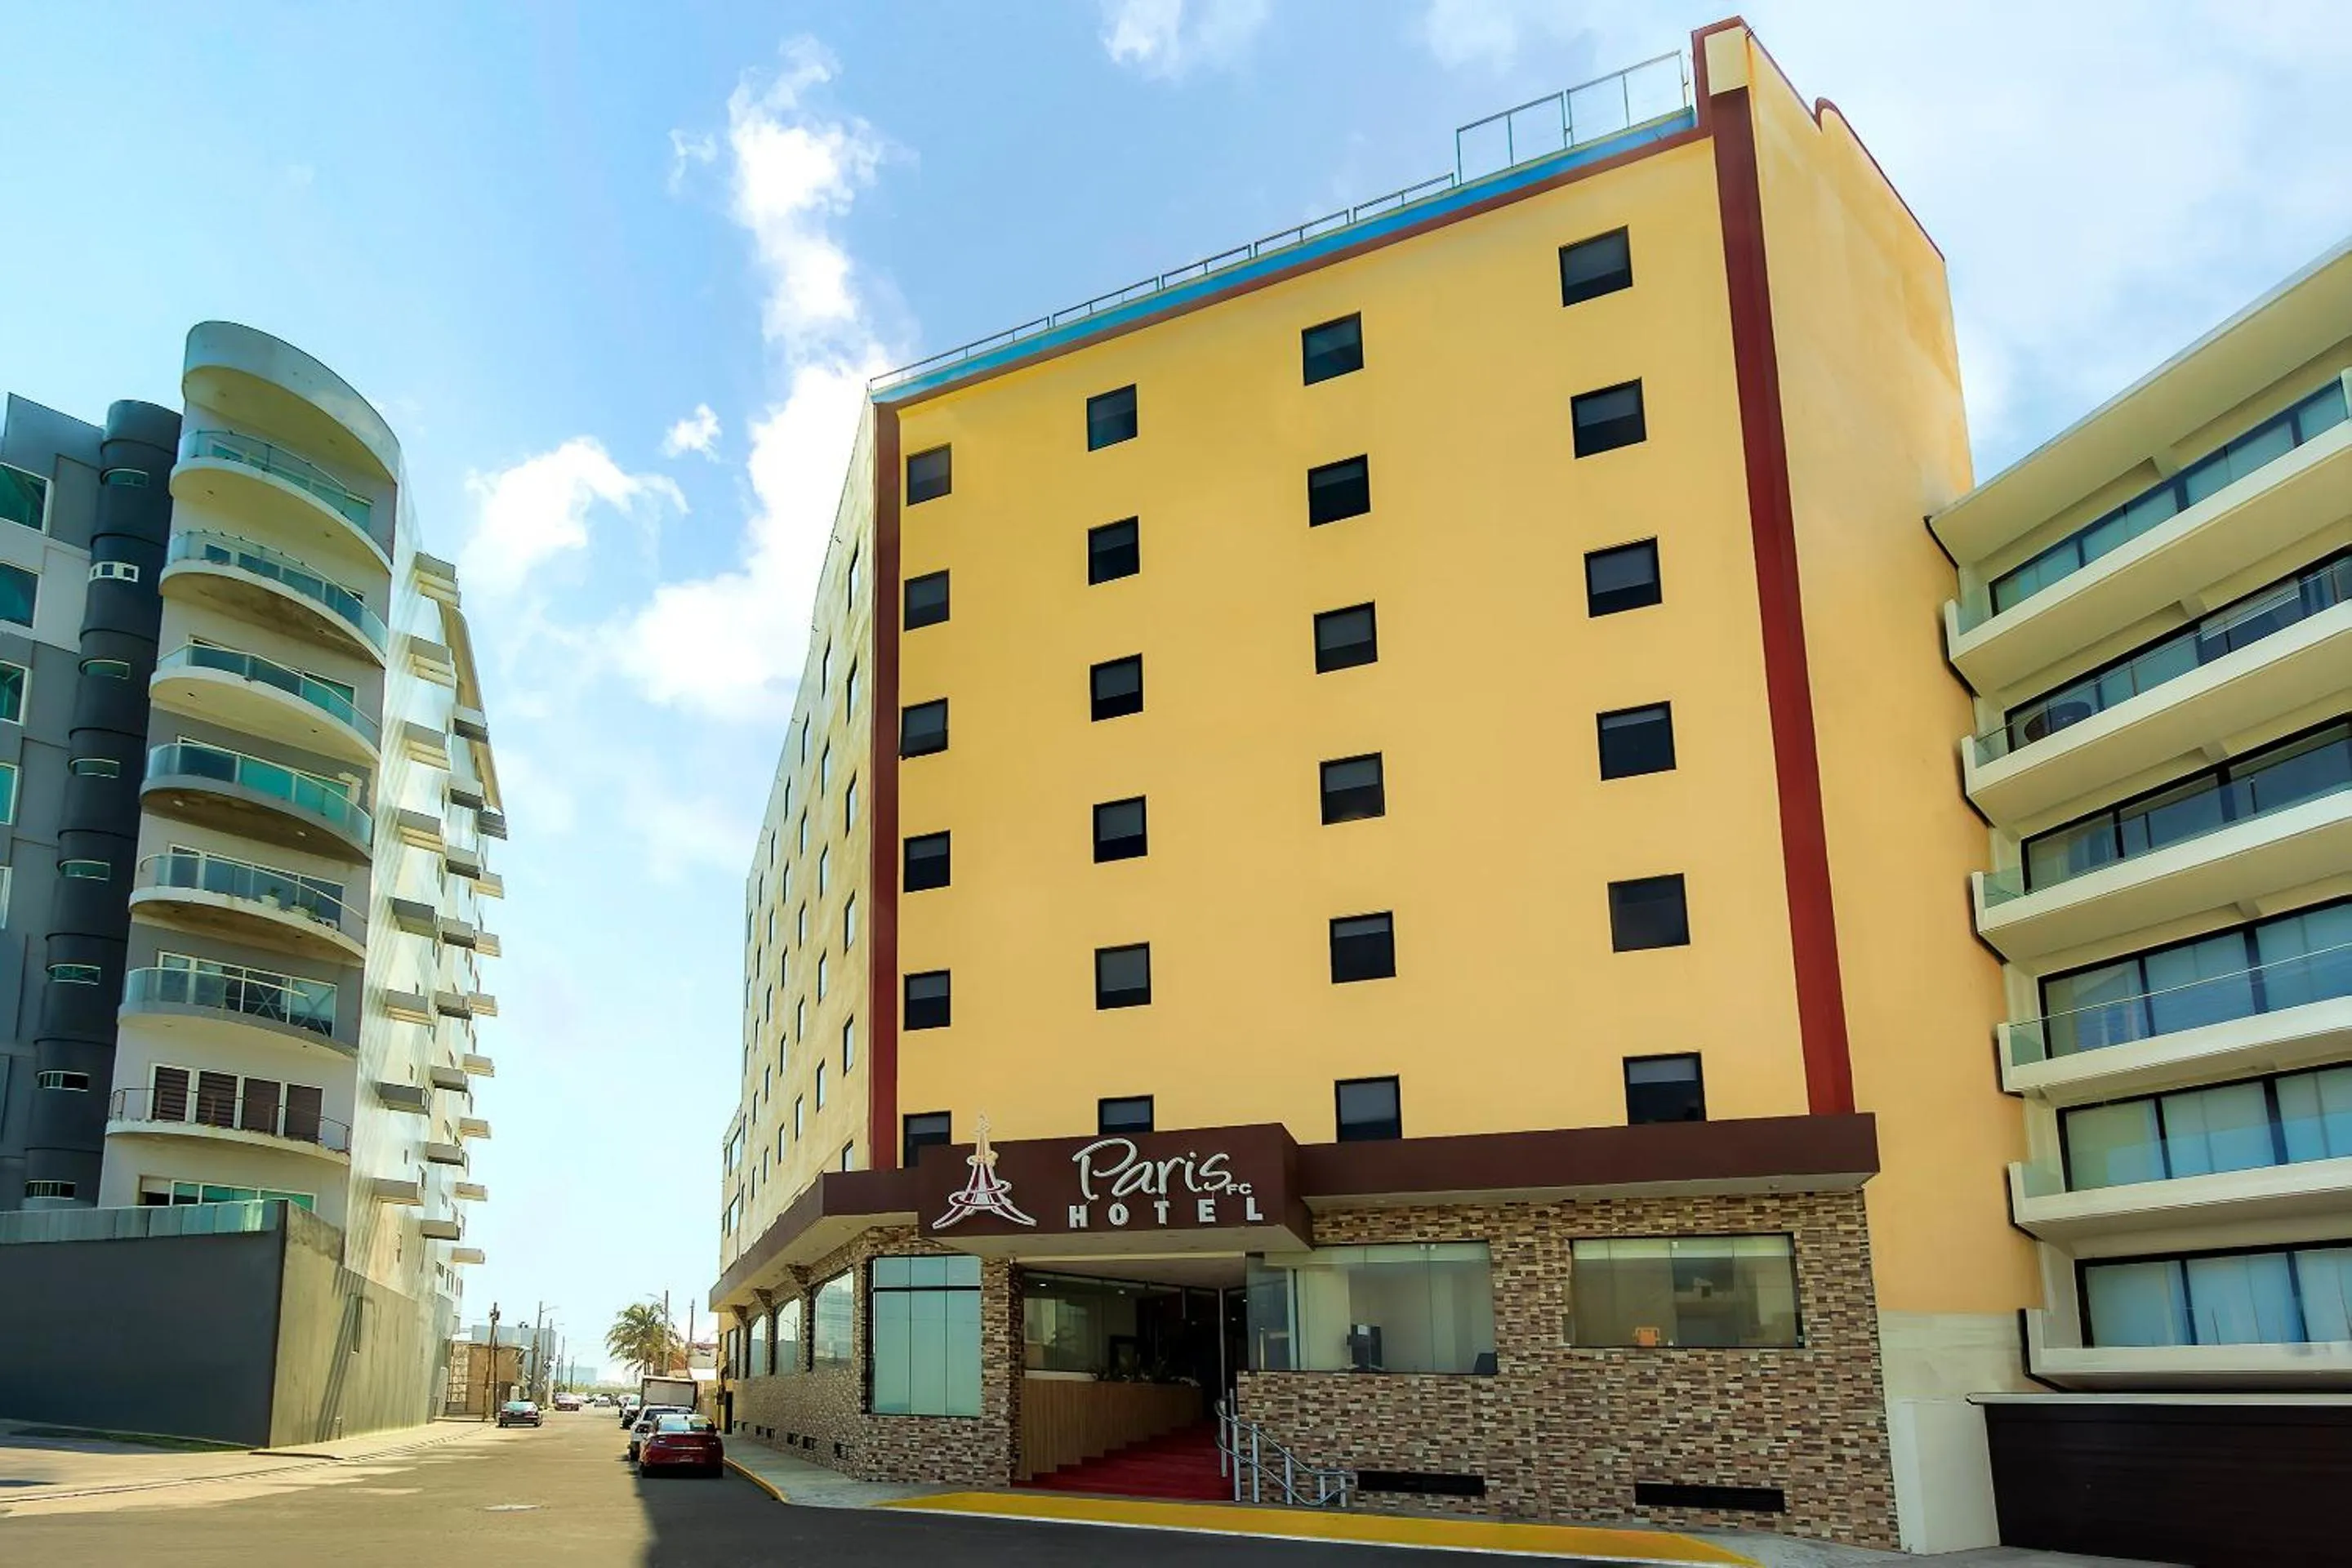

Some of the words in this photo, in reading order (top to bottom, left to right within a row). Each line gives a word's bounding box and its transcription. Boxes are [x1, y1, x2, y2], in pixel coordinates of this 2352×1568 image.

[1071, 1138, 1232, 1200] Paris
[1226, 1183, 1253, 1196] FC
[1068, 1196, 1264, 1228] HOTEL
